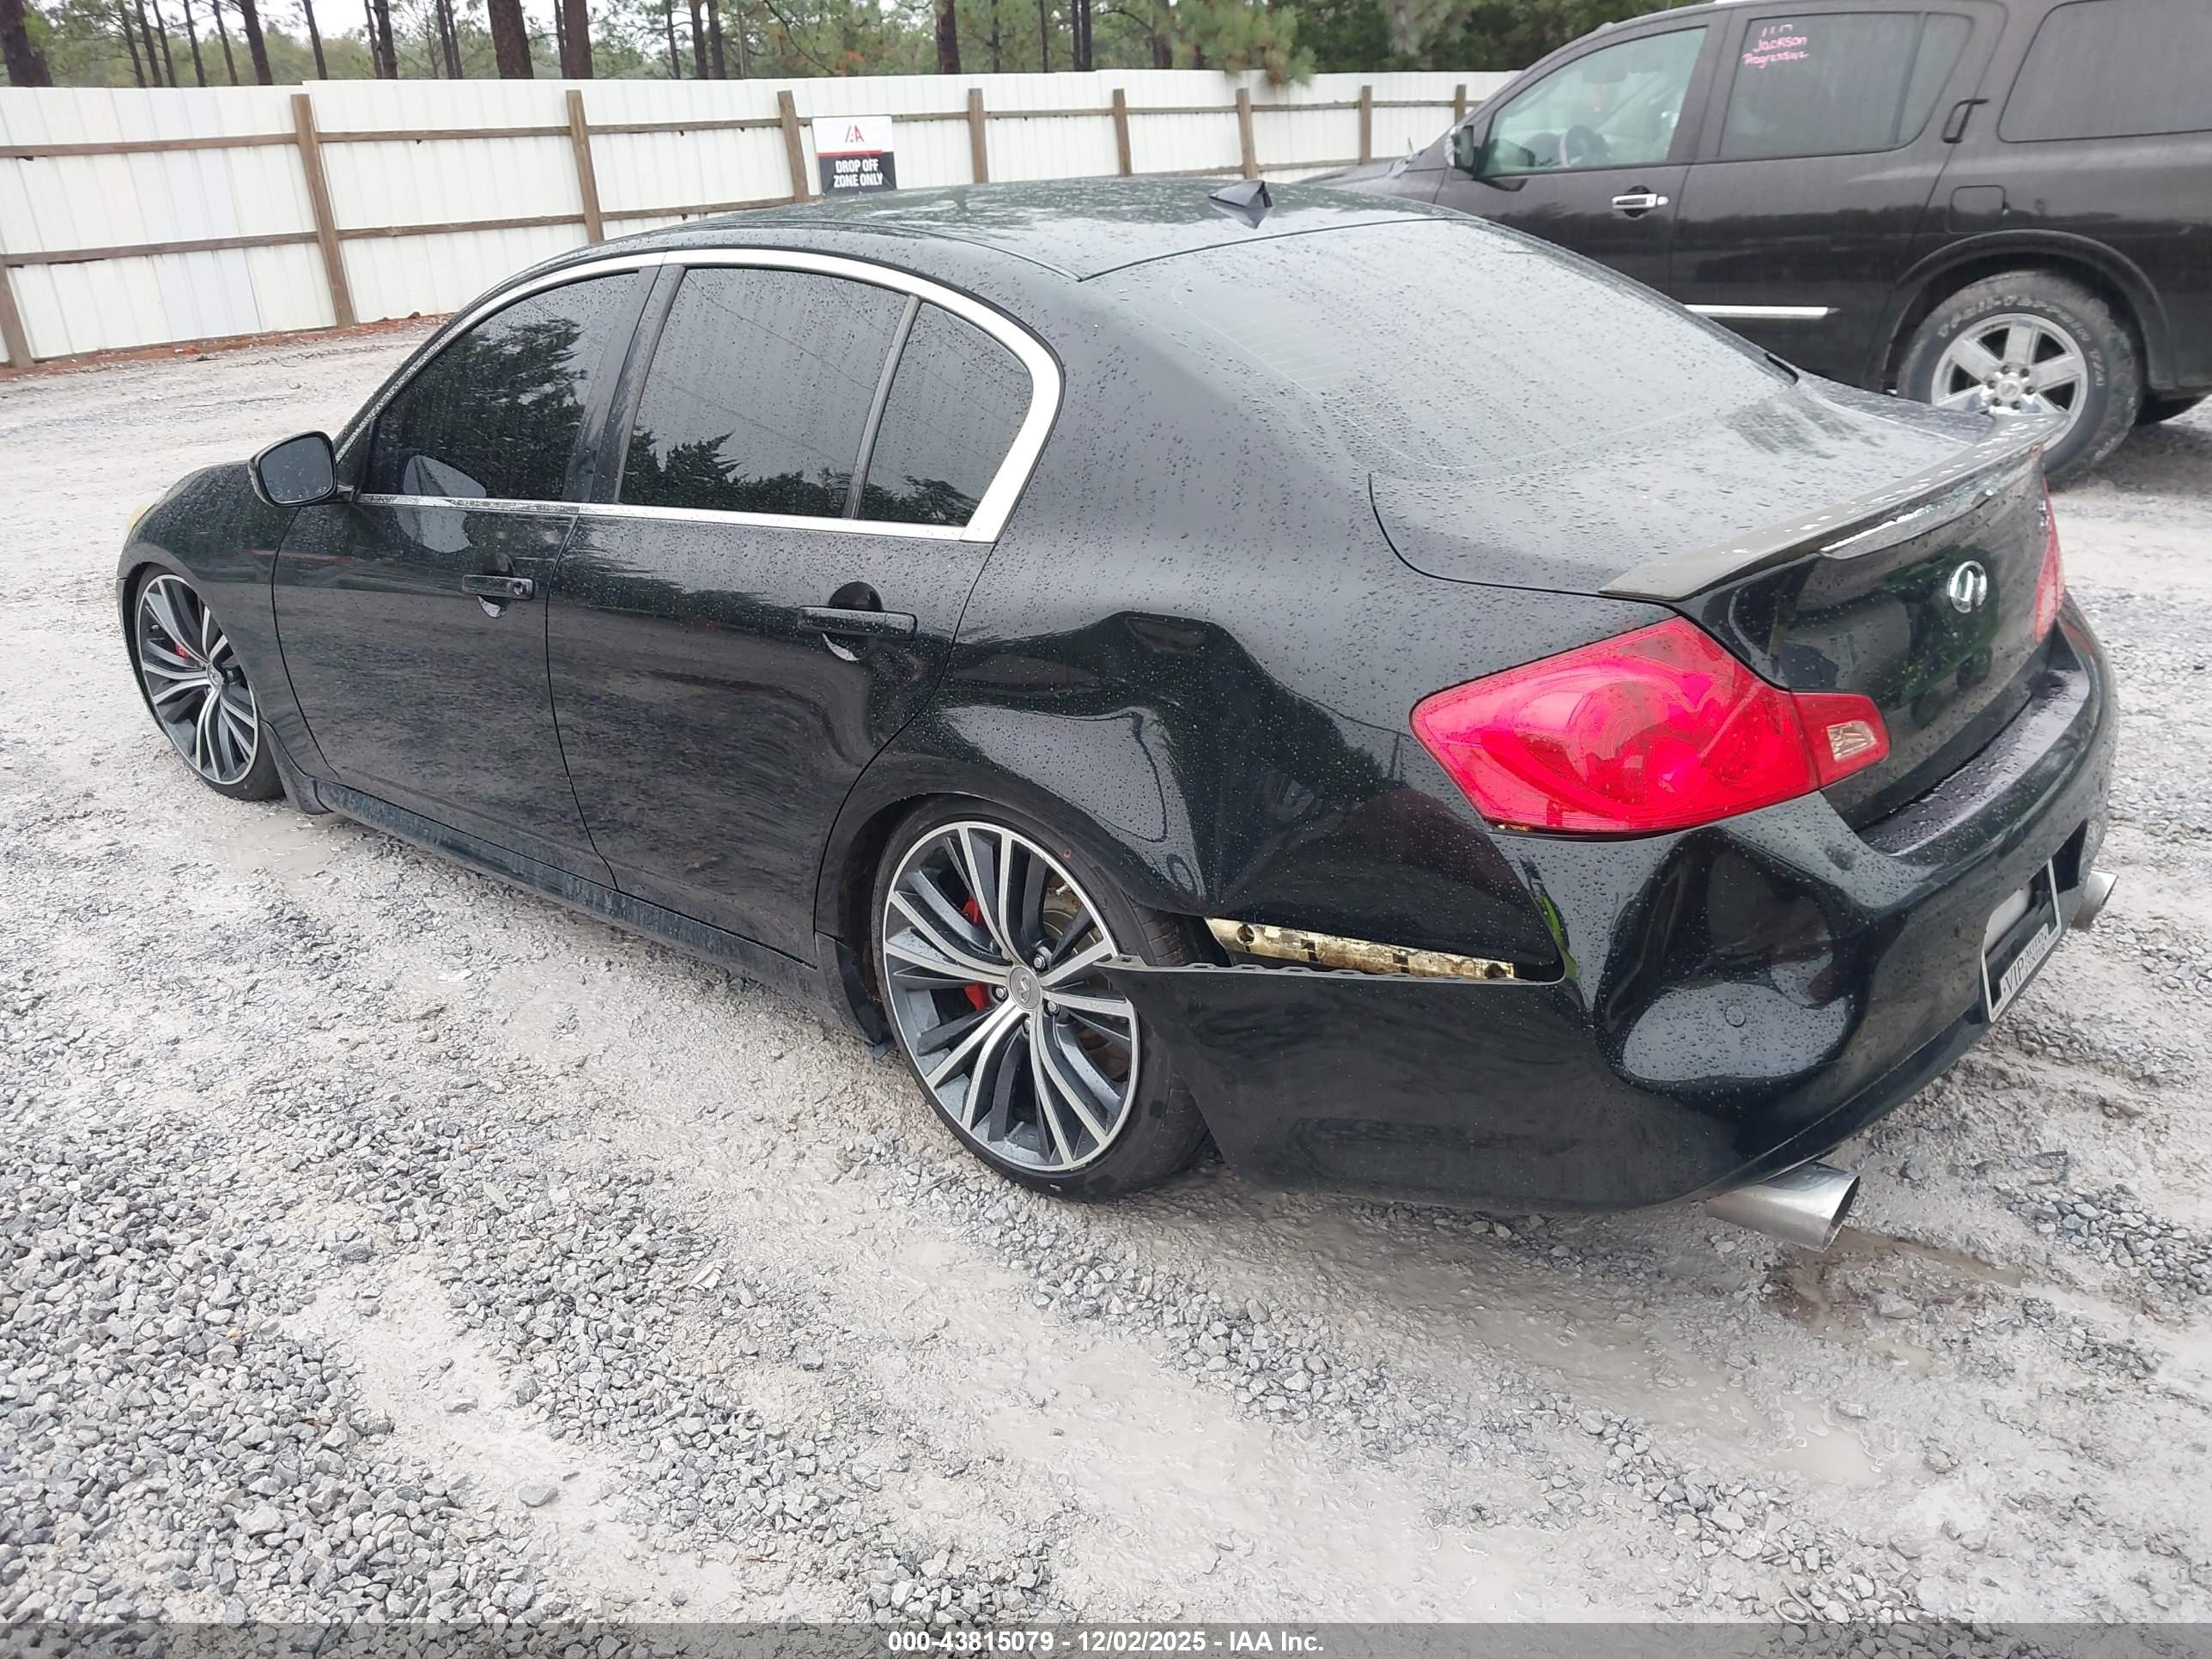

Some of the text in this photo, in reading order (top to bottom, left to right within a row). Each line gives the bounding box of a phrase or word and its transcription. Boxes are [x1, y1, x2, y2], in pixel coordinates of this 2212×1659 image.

[835, 158, 879, 173] DROP OFF
[833, 172, 884, 188] ZONE ONLY
[2005, 957, 2024, 994] VIP
